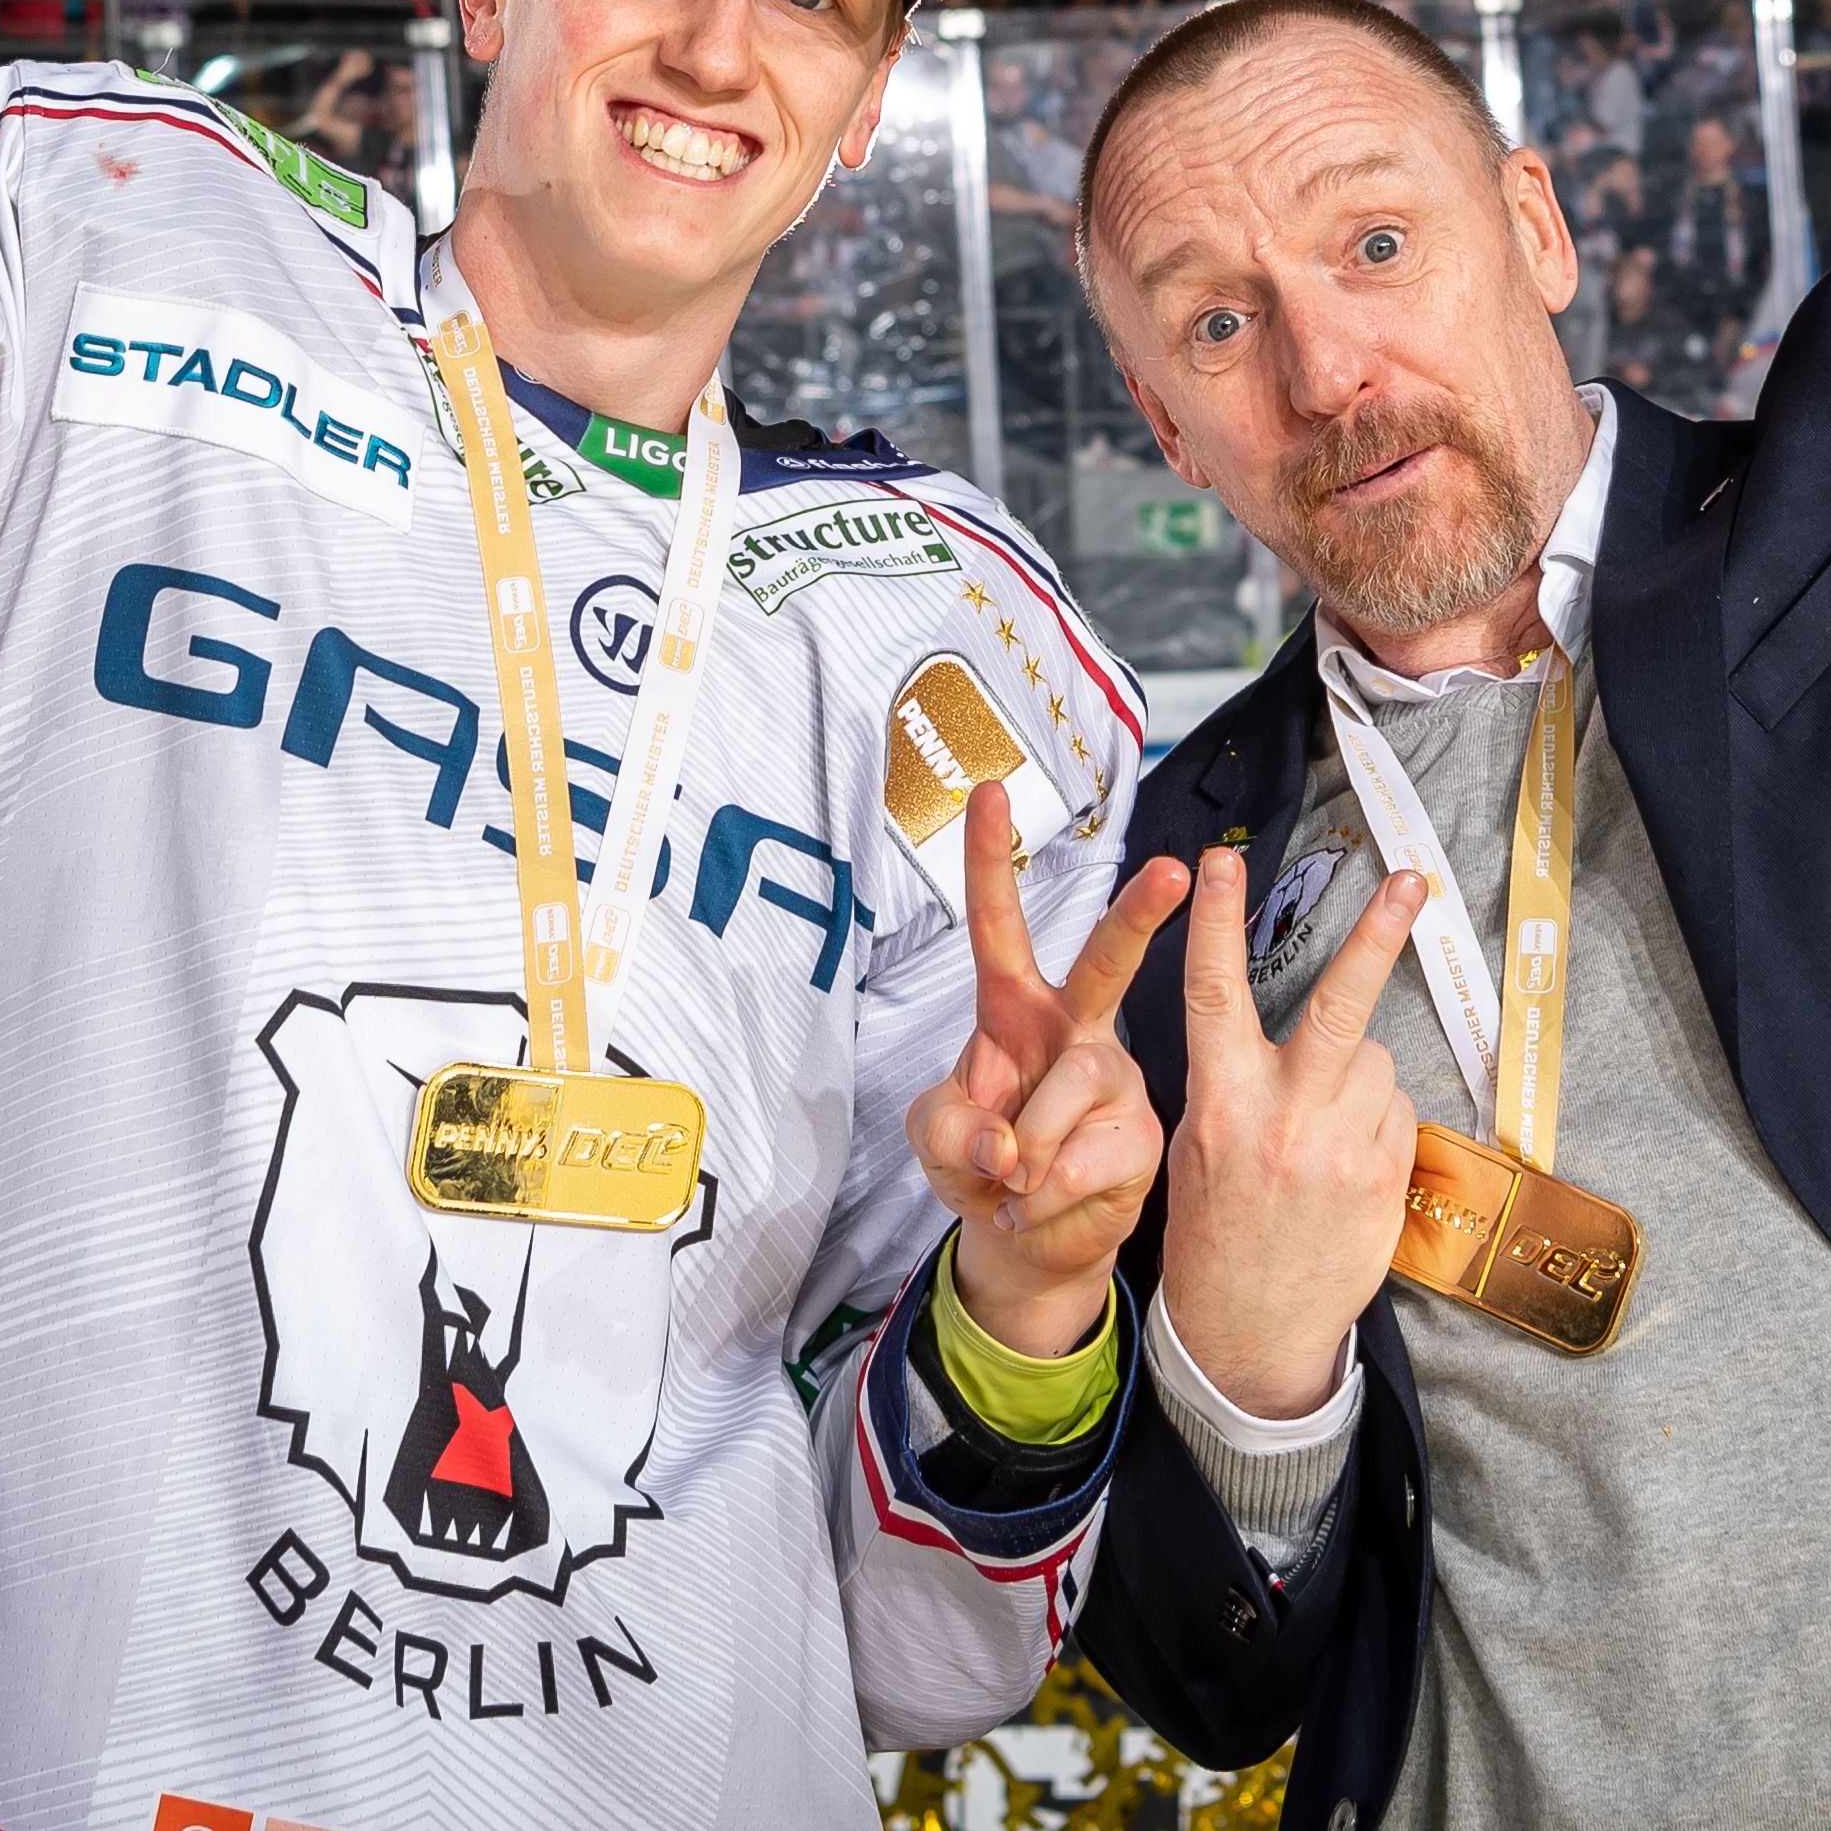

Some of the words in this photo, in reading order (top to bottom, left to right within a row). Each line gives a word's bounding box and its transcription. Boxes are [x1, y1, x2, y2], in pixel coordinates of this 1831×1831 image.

[69, 332, 412, 490] STADLER
[687, 496, 715, 590] DEUTSCHER
[706, 439, 721, 497] MEISTER
[730, 509, 934, 580] structure
[93, 562, 876, 995] GASA
[613, 788, 653, 894] DEUTSCHER
[643, 711, 671, 789] MEISTER
[1438, 934, 1473, 1004] MEISTER
[1463, 1004, 1498, 1089] UTSCHER
[556, 1121, 692, 1175] DEL
[1499, 1224, 1627, 1303] DEL
[245, 1528, 659, 1722] BERLIN
